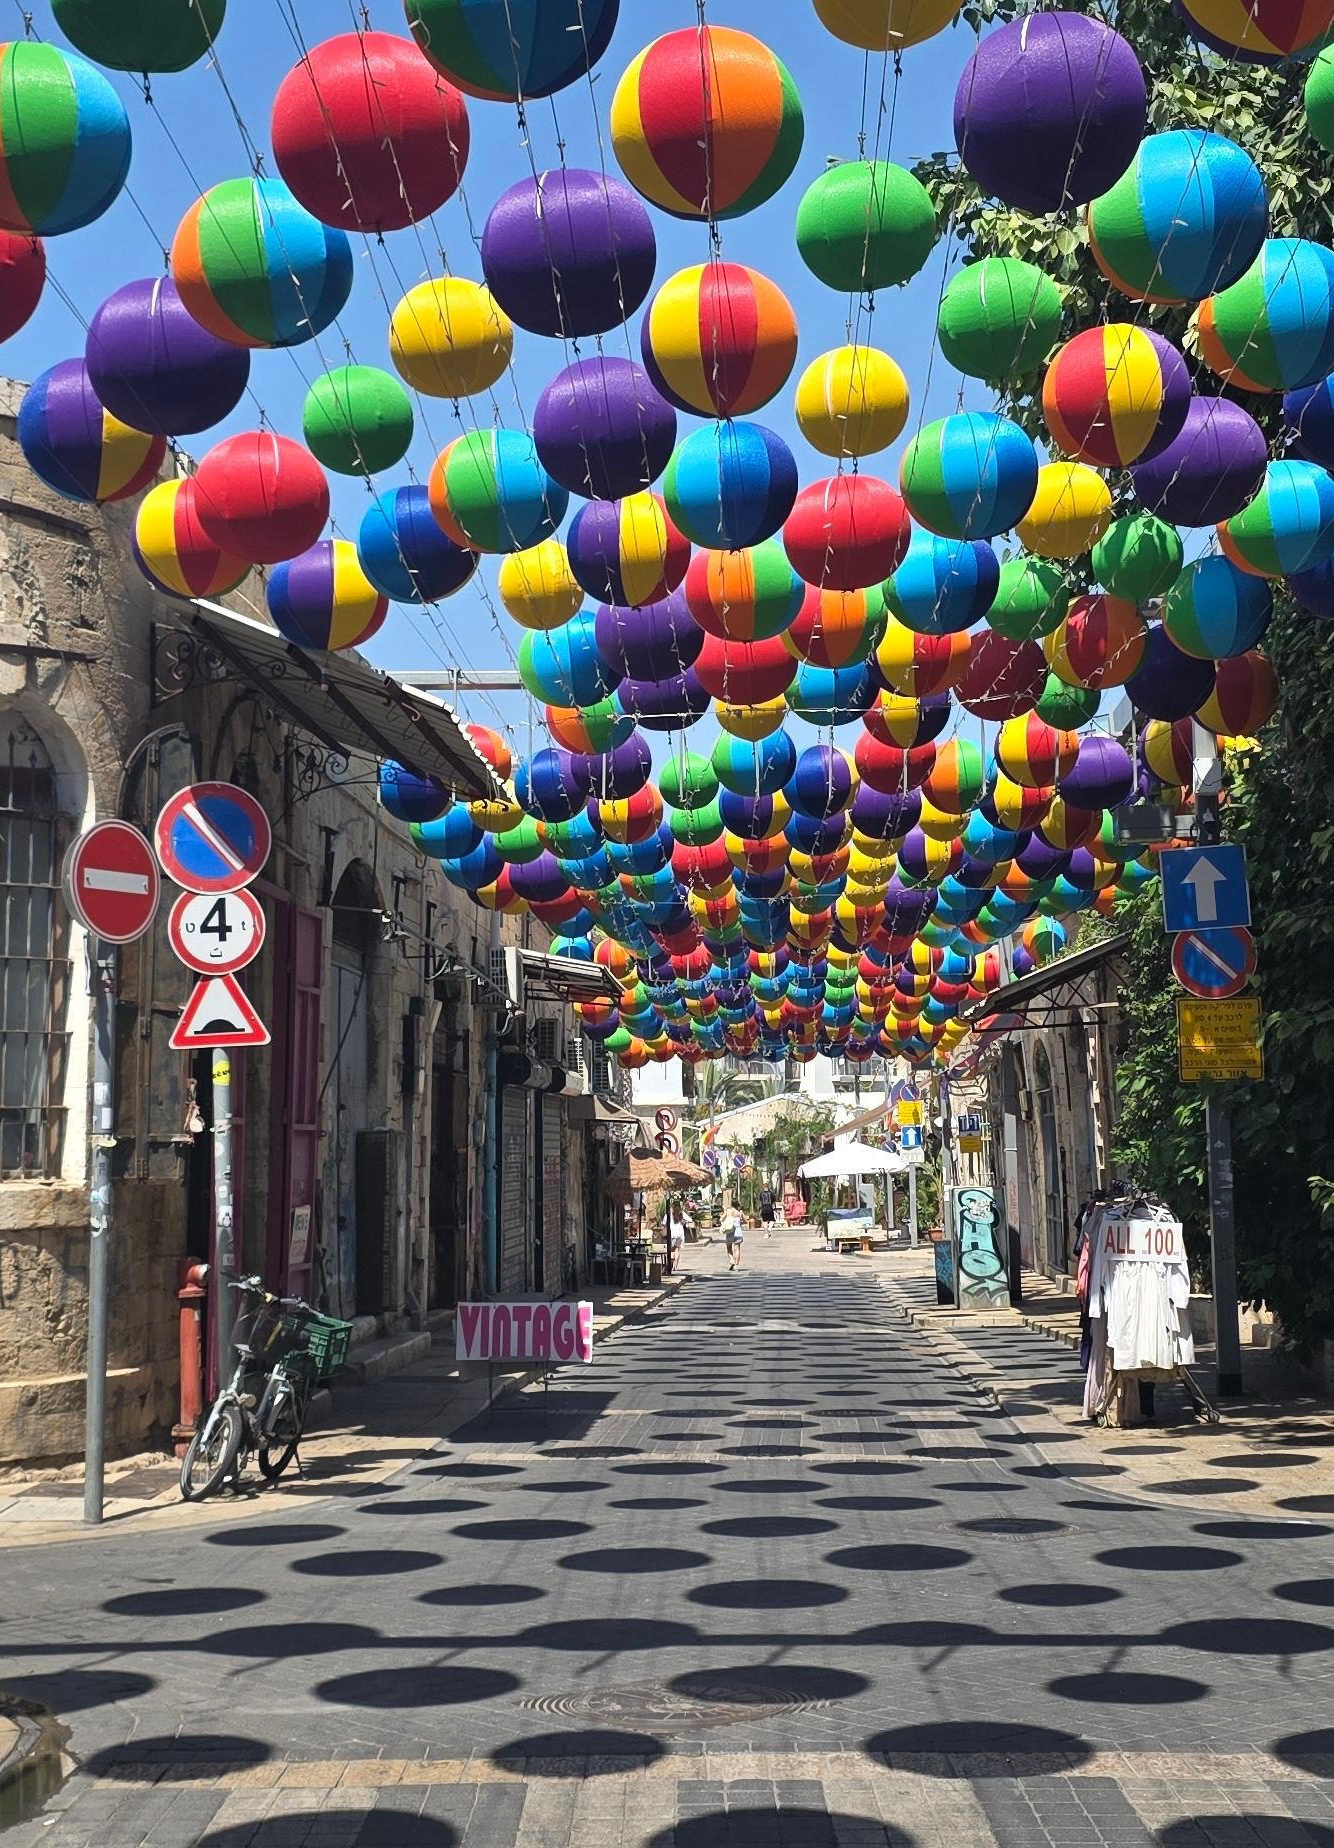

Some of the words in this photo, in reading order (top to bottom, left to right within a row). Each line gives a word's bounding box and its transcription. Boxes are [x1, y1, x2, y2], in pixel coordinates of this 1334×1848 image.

[200, 897, 232, 942] 4
[241, 920, 246, 931] t
[1104, 1225, 1135, 1254] ALL
[1145, 1227, 1174, 1256] 100
[459, 1304, 591, 1360] VINTAGE
